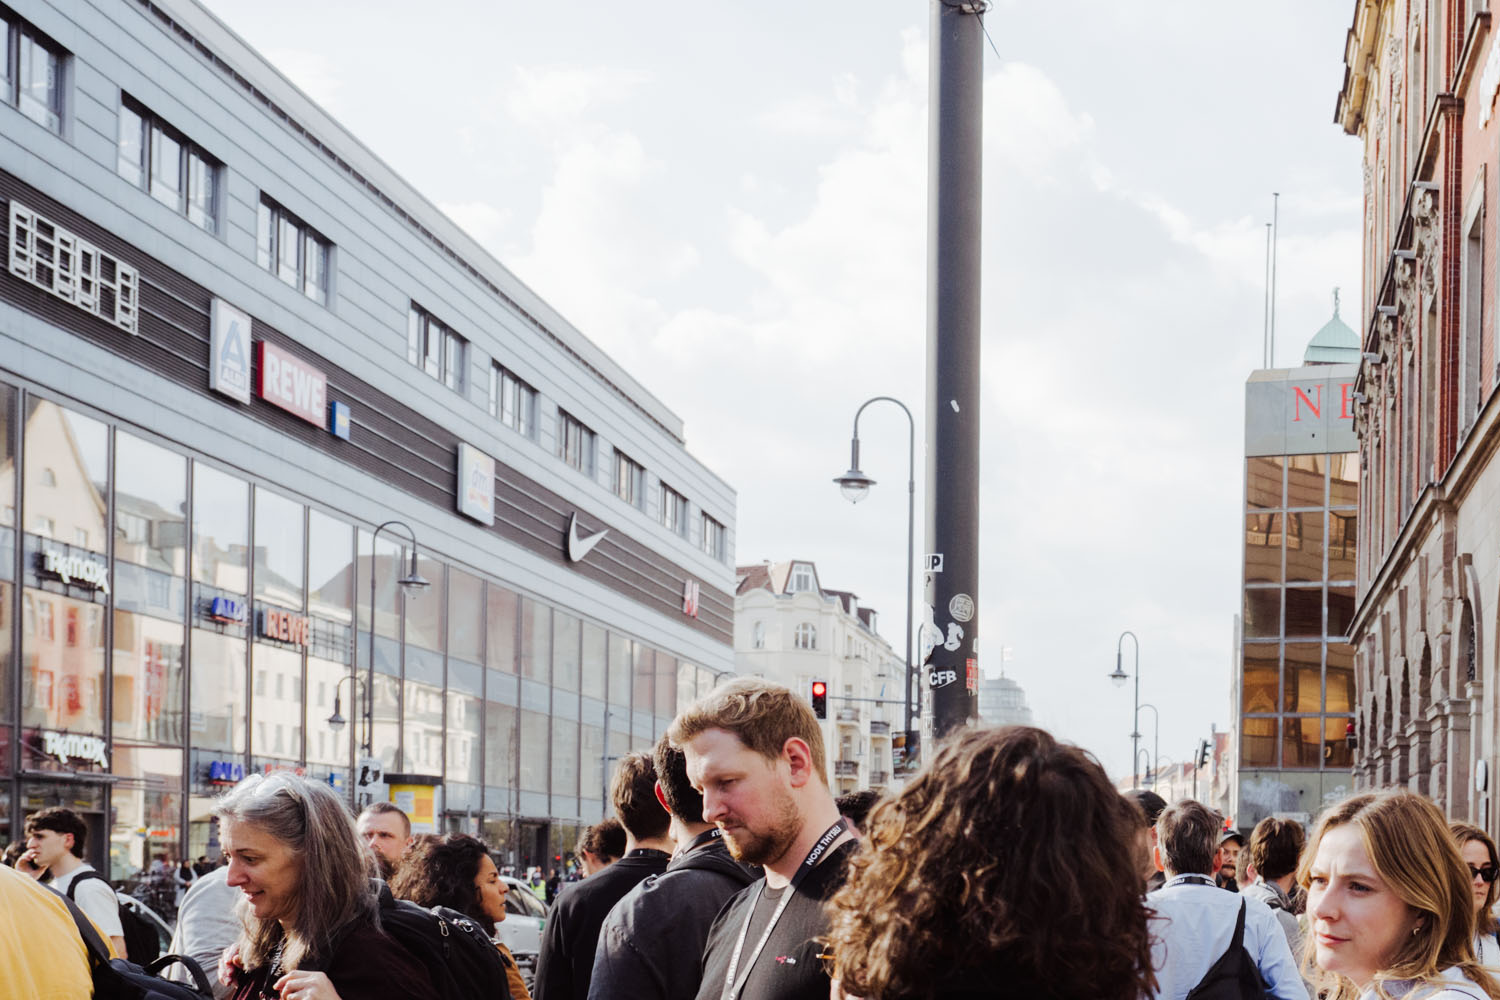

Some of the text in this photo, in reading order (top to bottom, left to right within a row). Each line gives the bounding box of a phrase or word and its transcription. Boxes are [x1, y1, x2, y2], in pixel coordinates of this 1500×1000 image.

[265, 351, 323, 418] REWE
[266, 608, 310, 646] REWE
[805, 844, 825, 866] NODE
